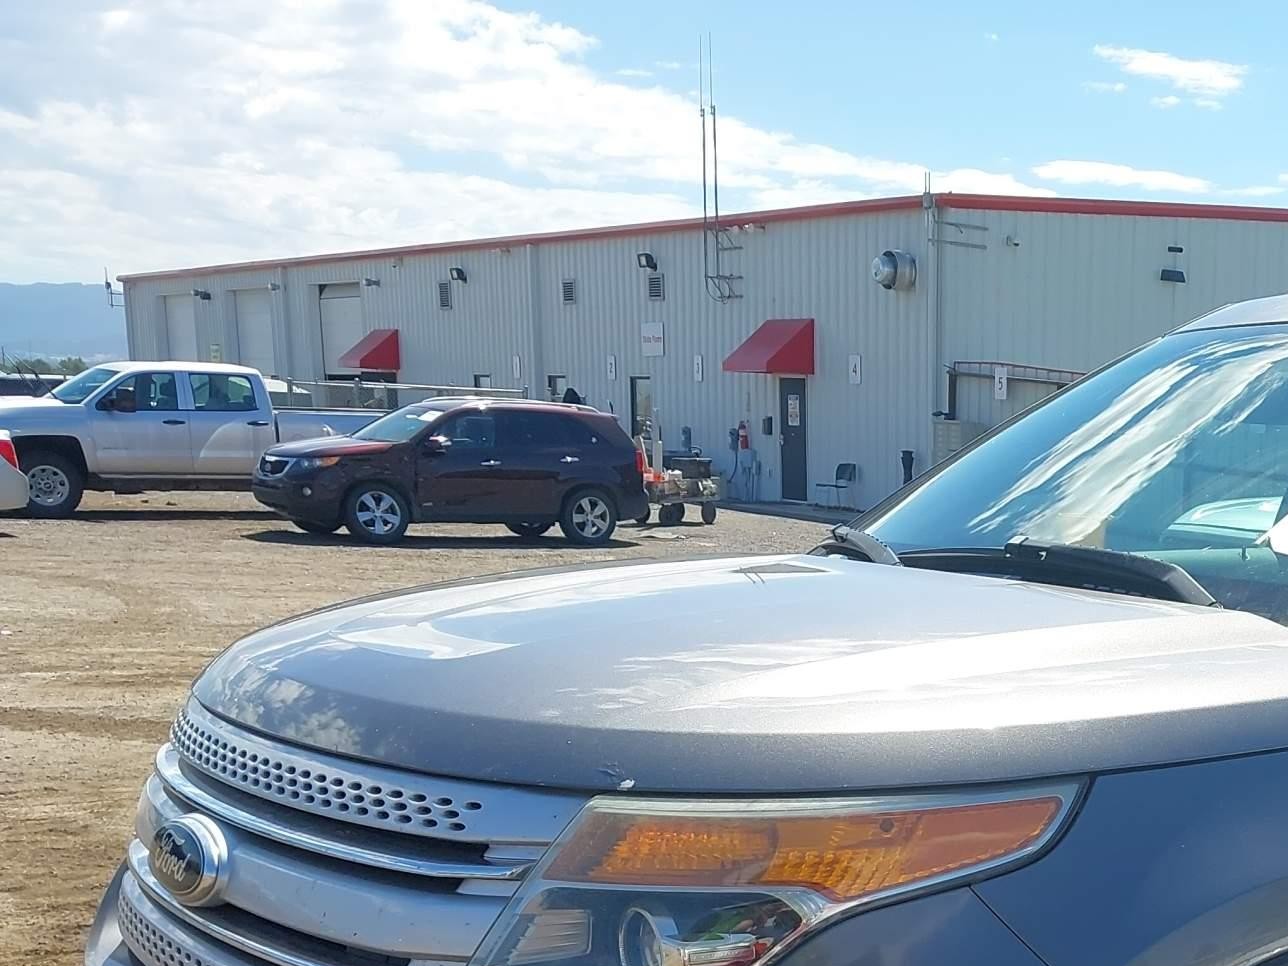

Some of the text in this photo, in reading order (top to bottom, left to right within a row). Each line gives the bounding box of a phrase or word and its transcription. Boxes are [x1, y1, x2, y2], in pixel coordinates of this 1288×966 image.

[852, 362, 858, 377] 4
[998, 376, 1004, 391] 5
[154, 829, 191, 882] Ford
